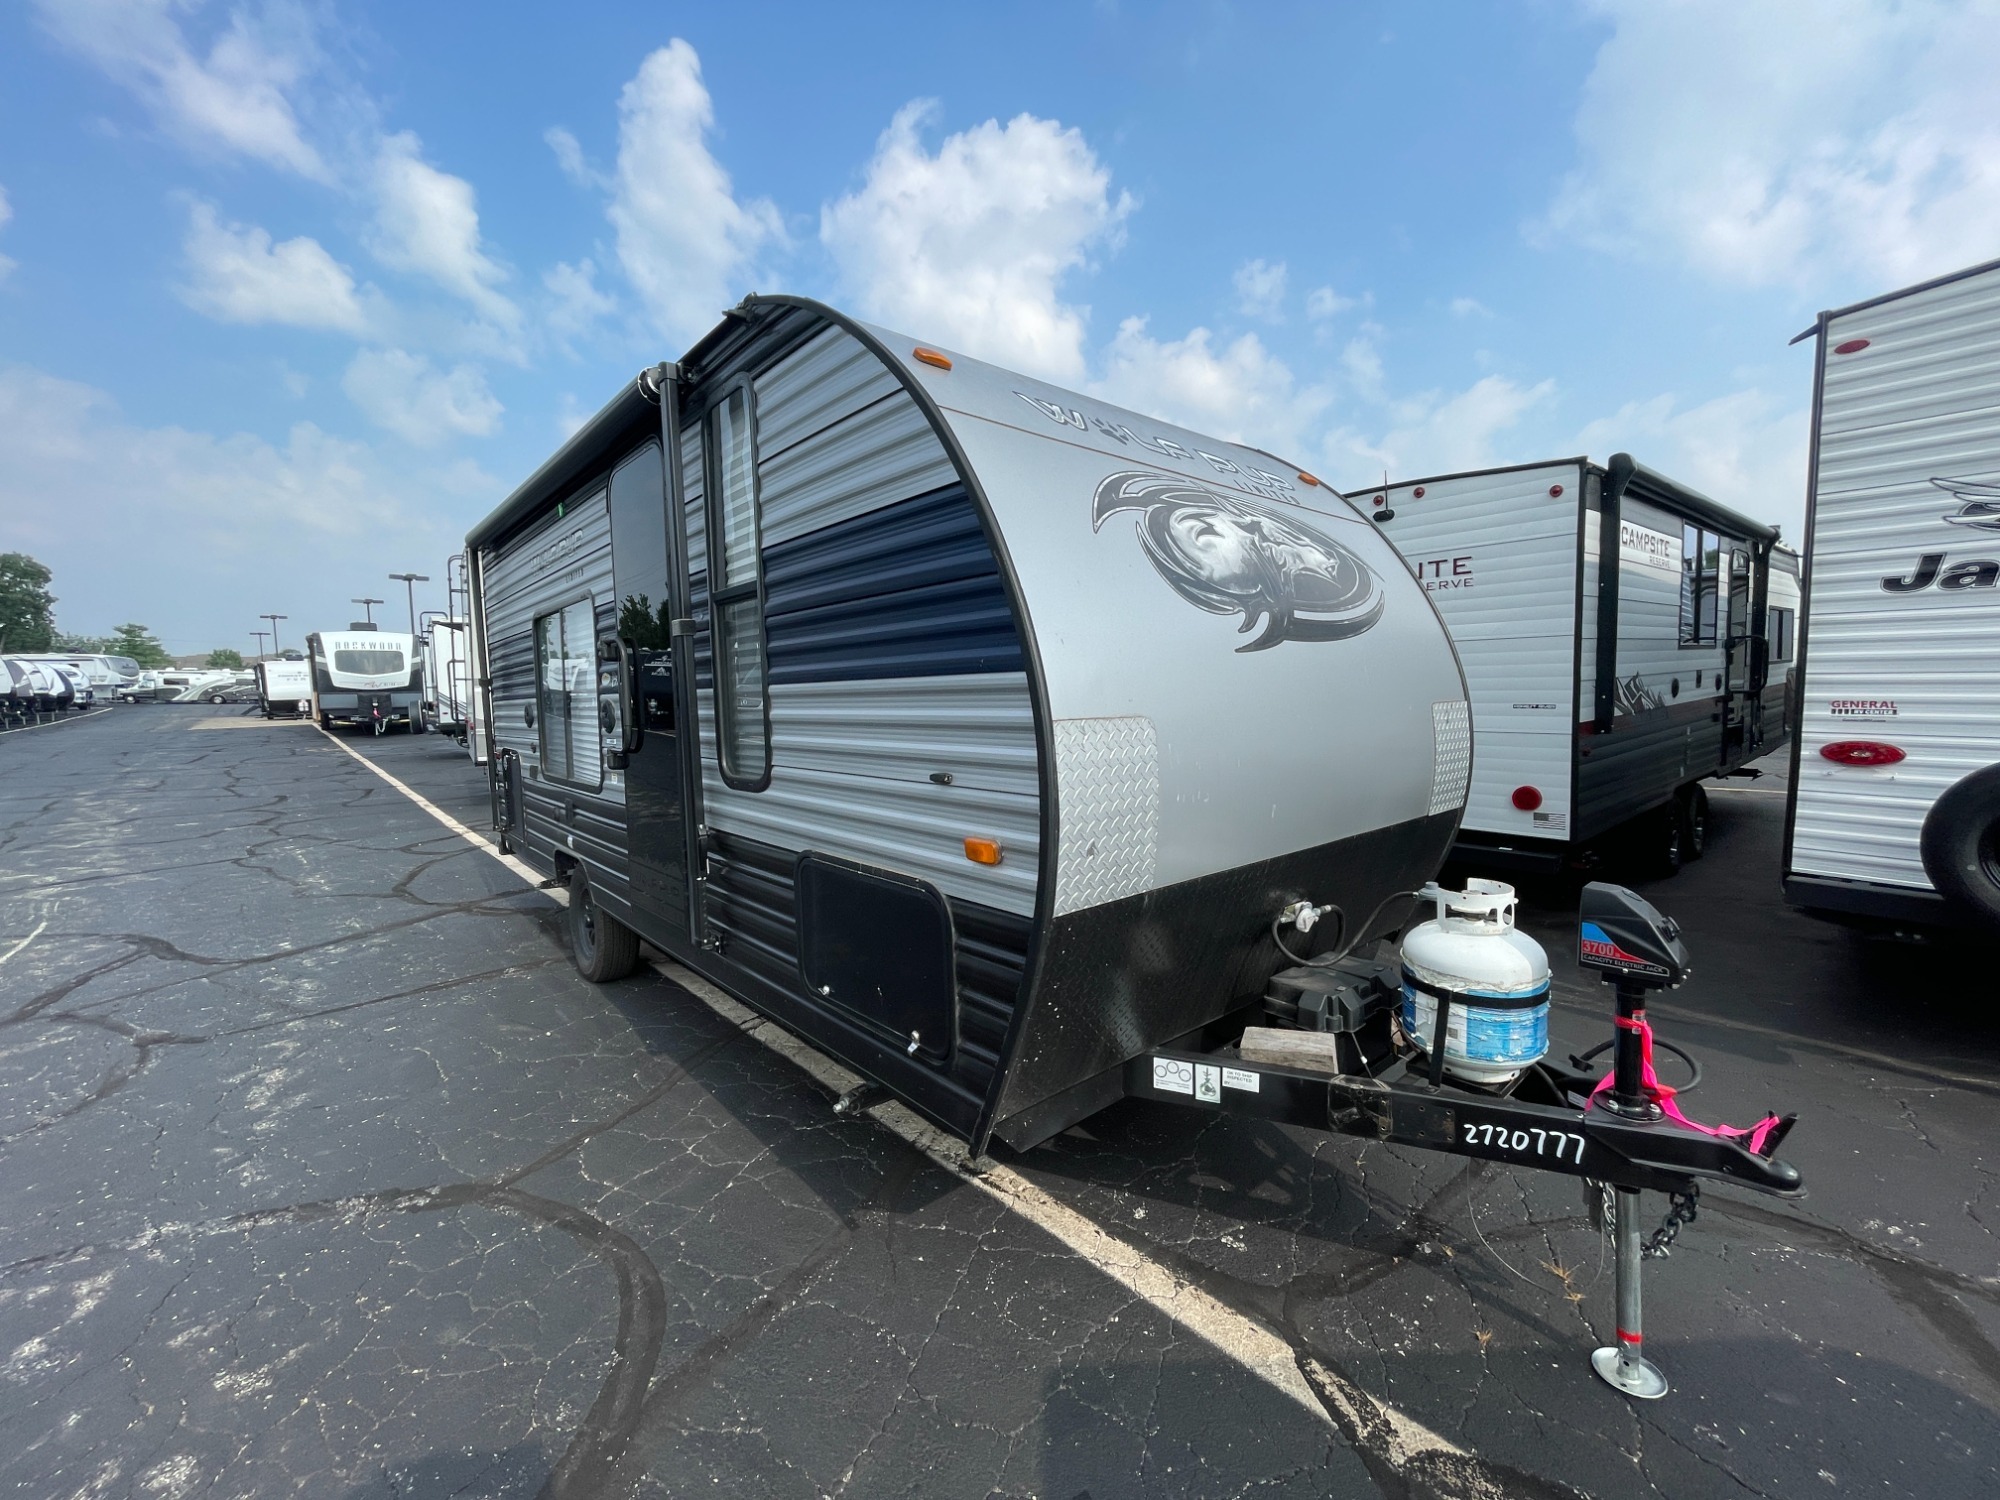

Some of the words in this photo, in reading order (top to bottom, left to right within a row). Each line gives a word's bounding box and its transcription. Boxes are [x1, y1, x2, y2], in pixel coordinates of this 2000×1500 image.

[1192, 447, 1296, 492] PUP
[1233, 479, 1301, 505] LIMITED
[1621, 526, 1670, 557] CAMPSITE
[1418, 556, 1472, 579] ITE
[1649, 555, 1670, 569] RESERVE
[1880, 552, 2000, 594] Ja
[1426, 577, 1474, 591] ERVE
[1831, 700, 1898, 708] GENERAL
[1583, 941, 1614, 956] 3700
[1583, 954, 1613, 965] CAPACITY
[1614, 960, 1645, 970] ELECTRIC
[1646, 964, 1664, 973] JACK
